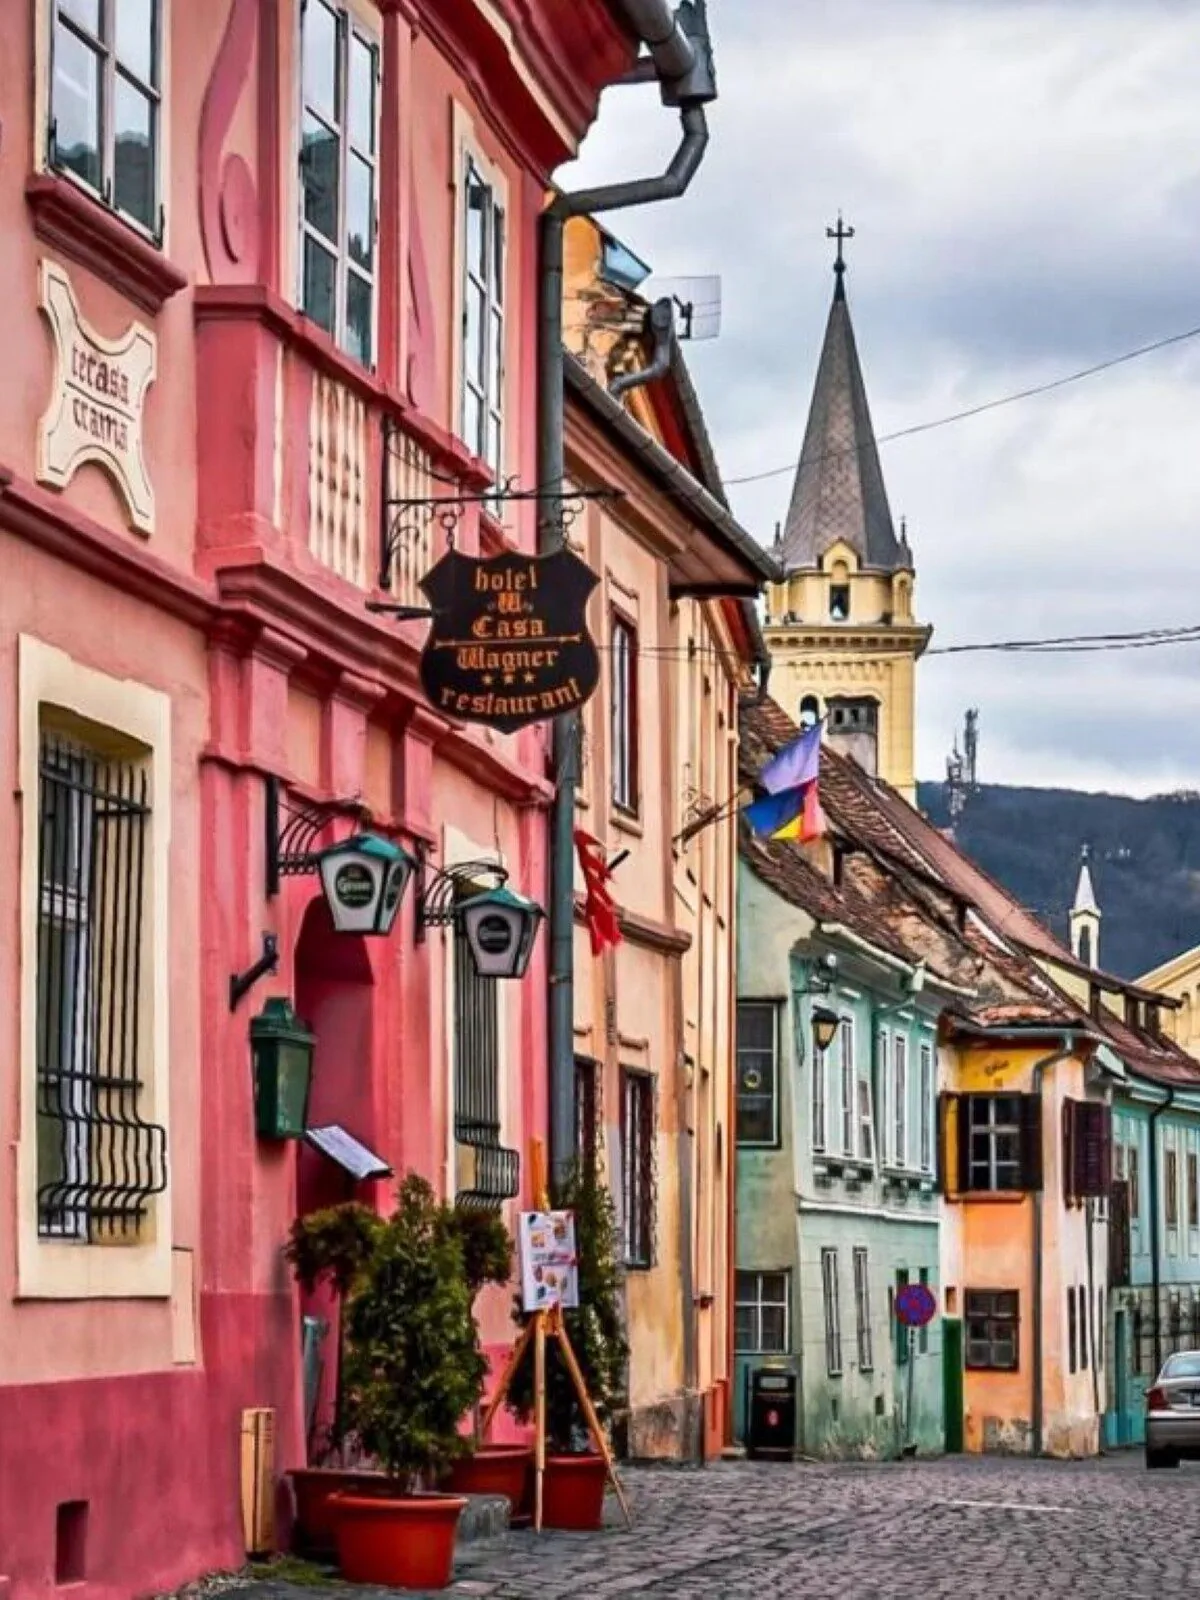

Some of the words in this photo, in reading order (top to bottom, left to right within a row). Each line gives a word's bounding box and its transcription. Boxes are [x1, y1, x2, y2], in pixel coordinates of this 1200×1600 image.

[72, 342, 129, 405] terasa
[474, 564, 539, 591] hotel
[472, 615, 545, 637] Casa
[456, 647, 559, 673] Wagner
[441, 677, 582, 714] restaurant
